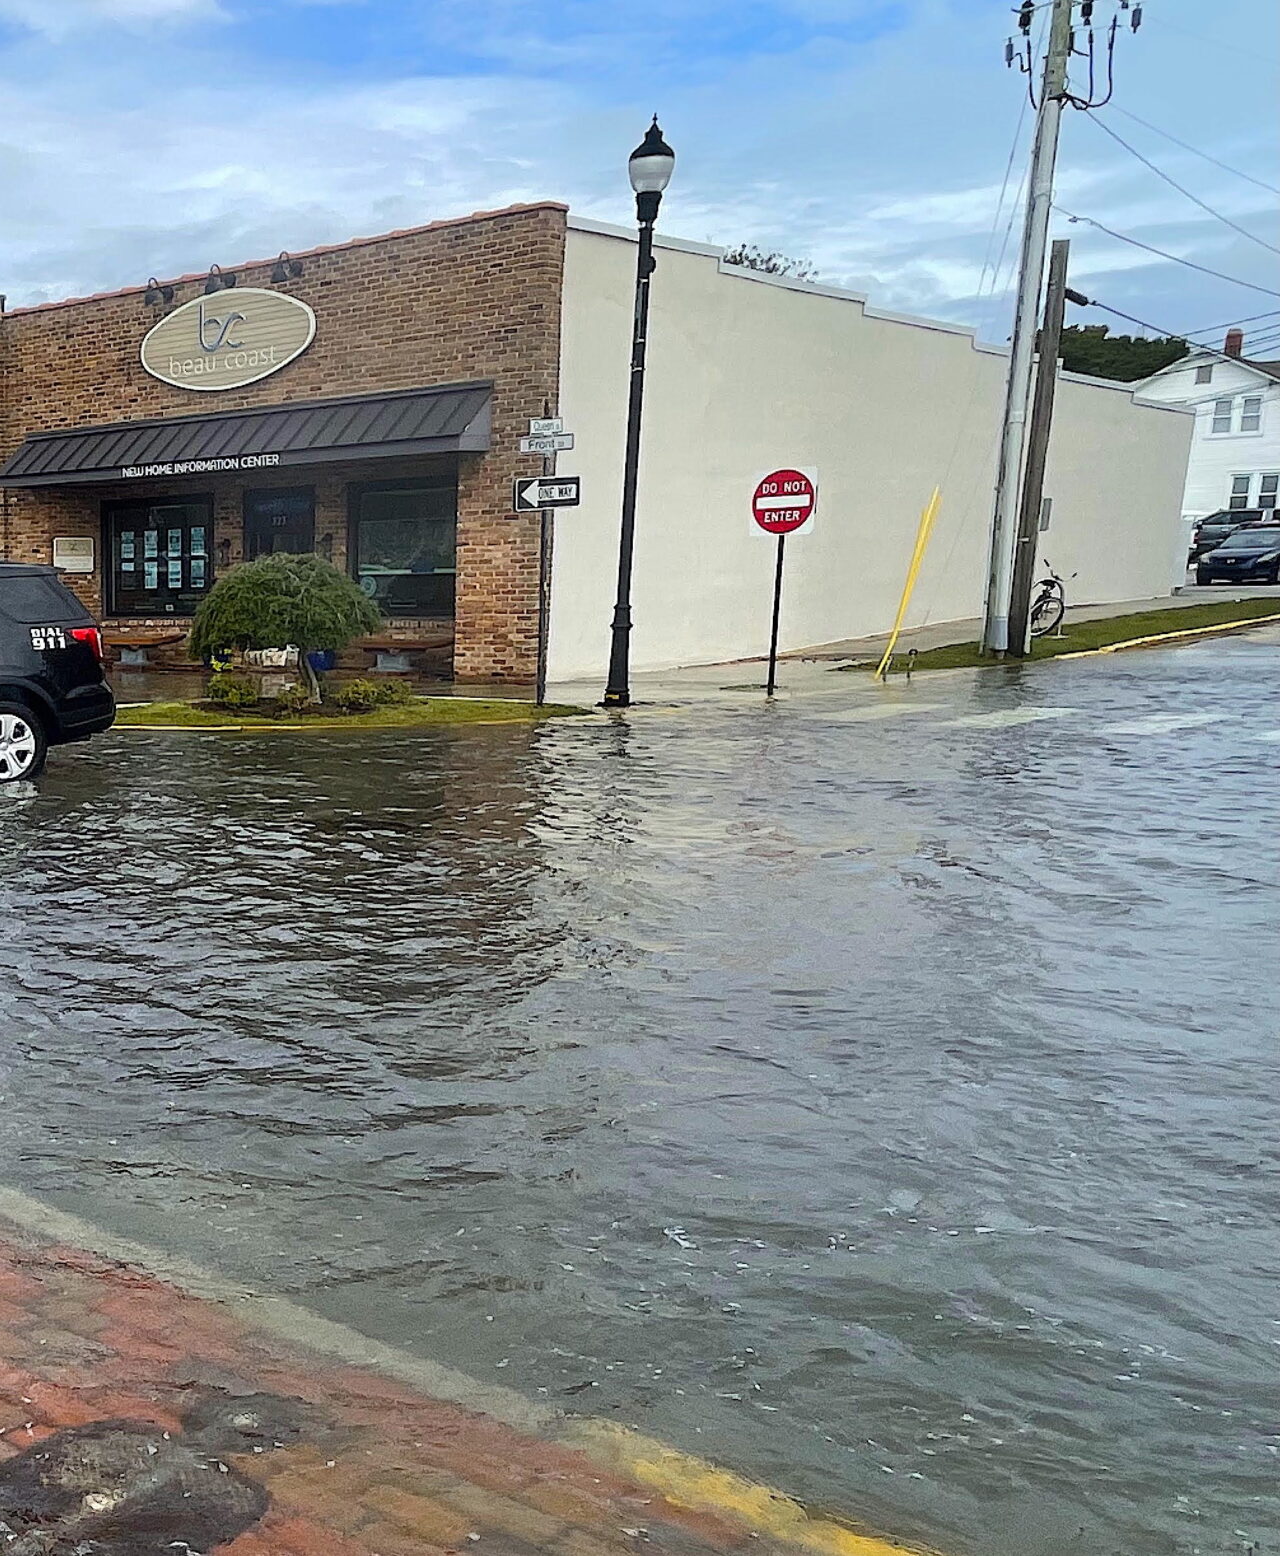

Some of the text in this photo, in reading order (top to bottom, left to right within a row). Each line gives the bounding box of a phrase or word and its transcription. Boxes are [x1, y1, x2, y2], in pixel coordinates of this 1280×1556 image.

[170, 346, 277, 377] beau coast
[528, 439, 555, 450] Front
[122, 453, 280, 478] NEW HOME INFORMATION CENTER
[538, 486, 573, 499] ONE WAY
[762, 480, 807, 494] DO NOT
[764, 510, 801, 523] ENTER
[30, 627, 65, 638] DIAL
[32, 636, 66, 651] 911
